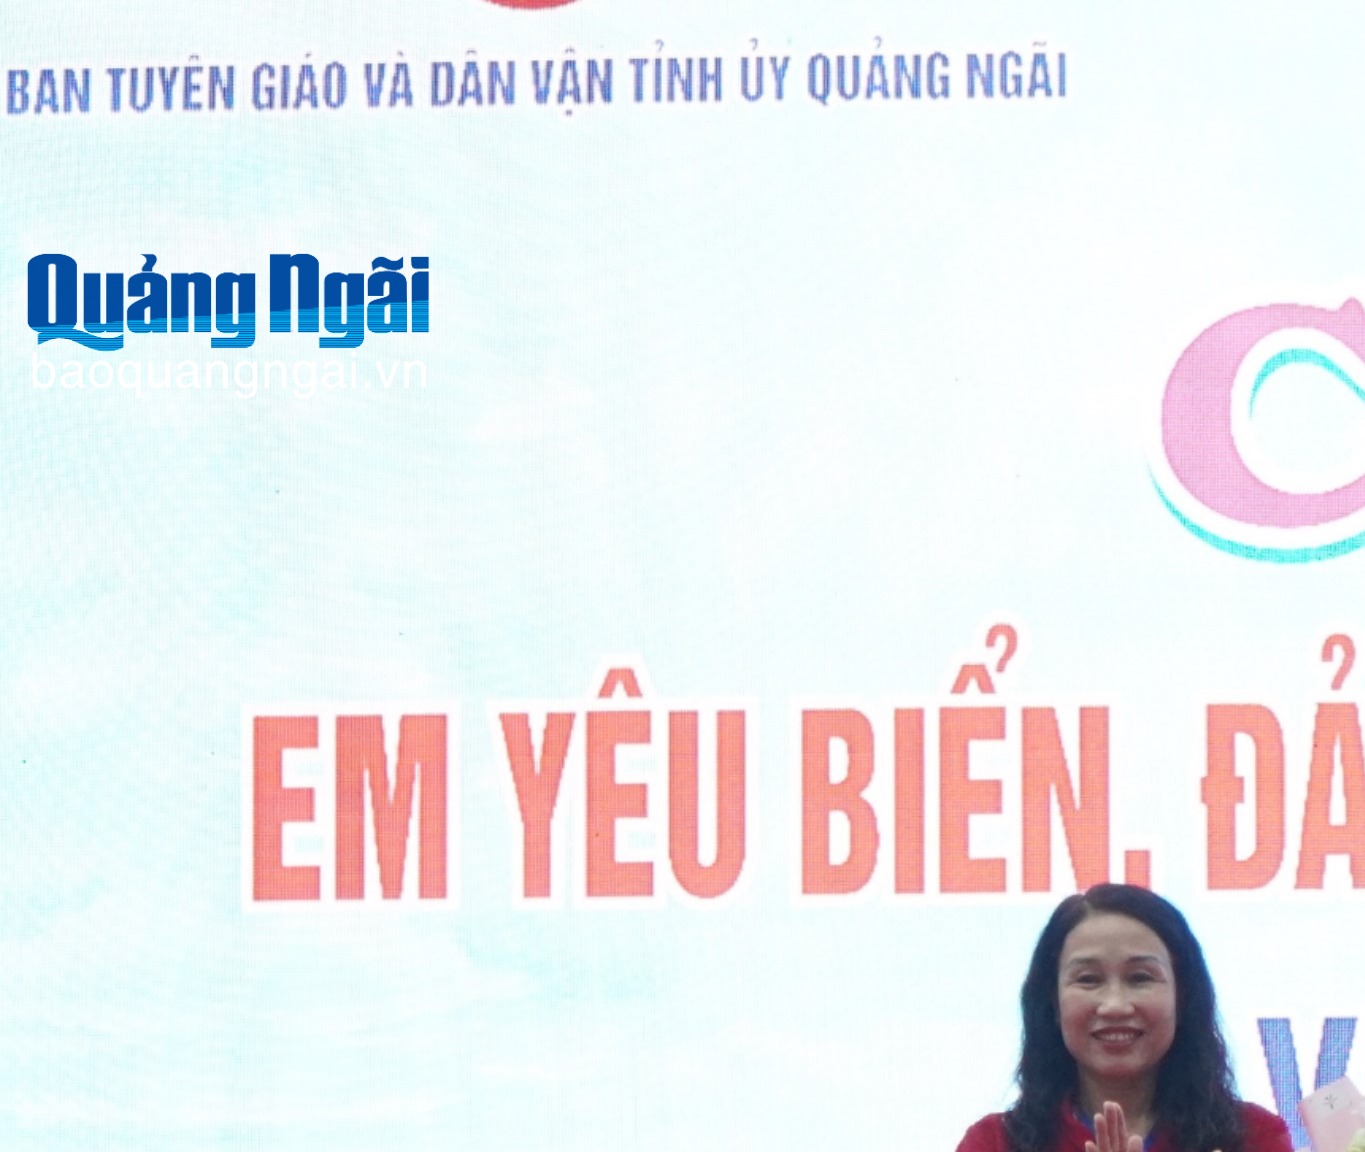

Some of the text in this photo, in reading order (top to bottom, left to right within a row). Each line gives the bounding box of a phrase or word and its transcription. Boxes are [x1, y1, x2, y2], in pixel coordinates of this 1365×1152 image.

[7, 35, 1067, 116] BAN TUYÊN GIÁO VÀ DÂN VẬN TỈNH ỦY QUẢNG NGÃI
[252, 714, 448, 900] EM
[497, 667, 746, 898] YÊU
